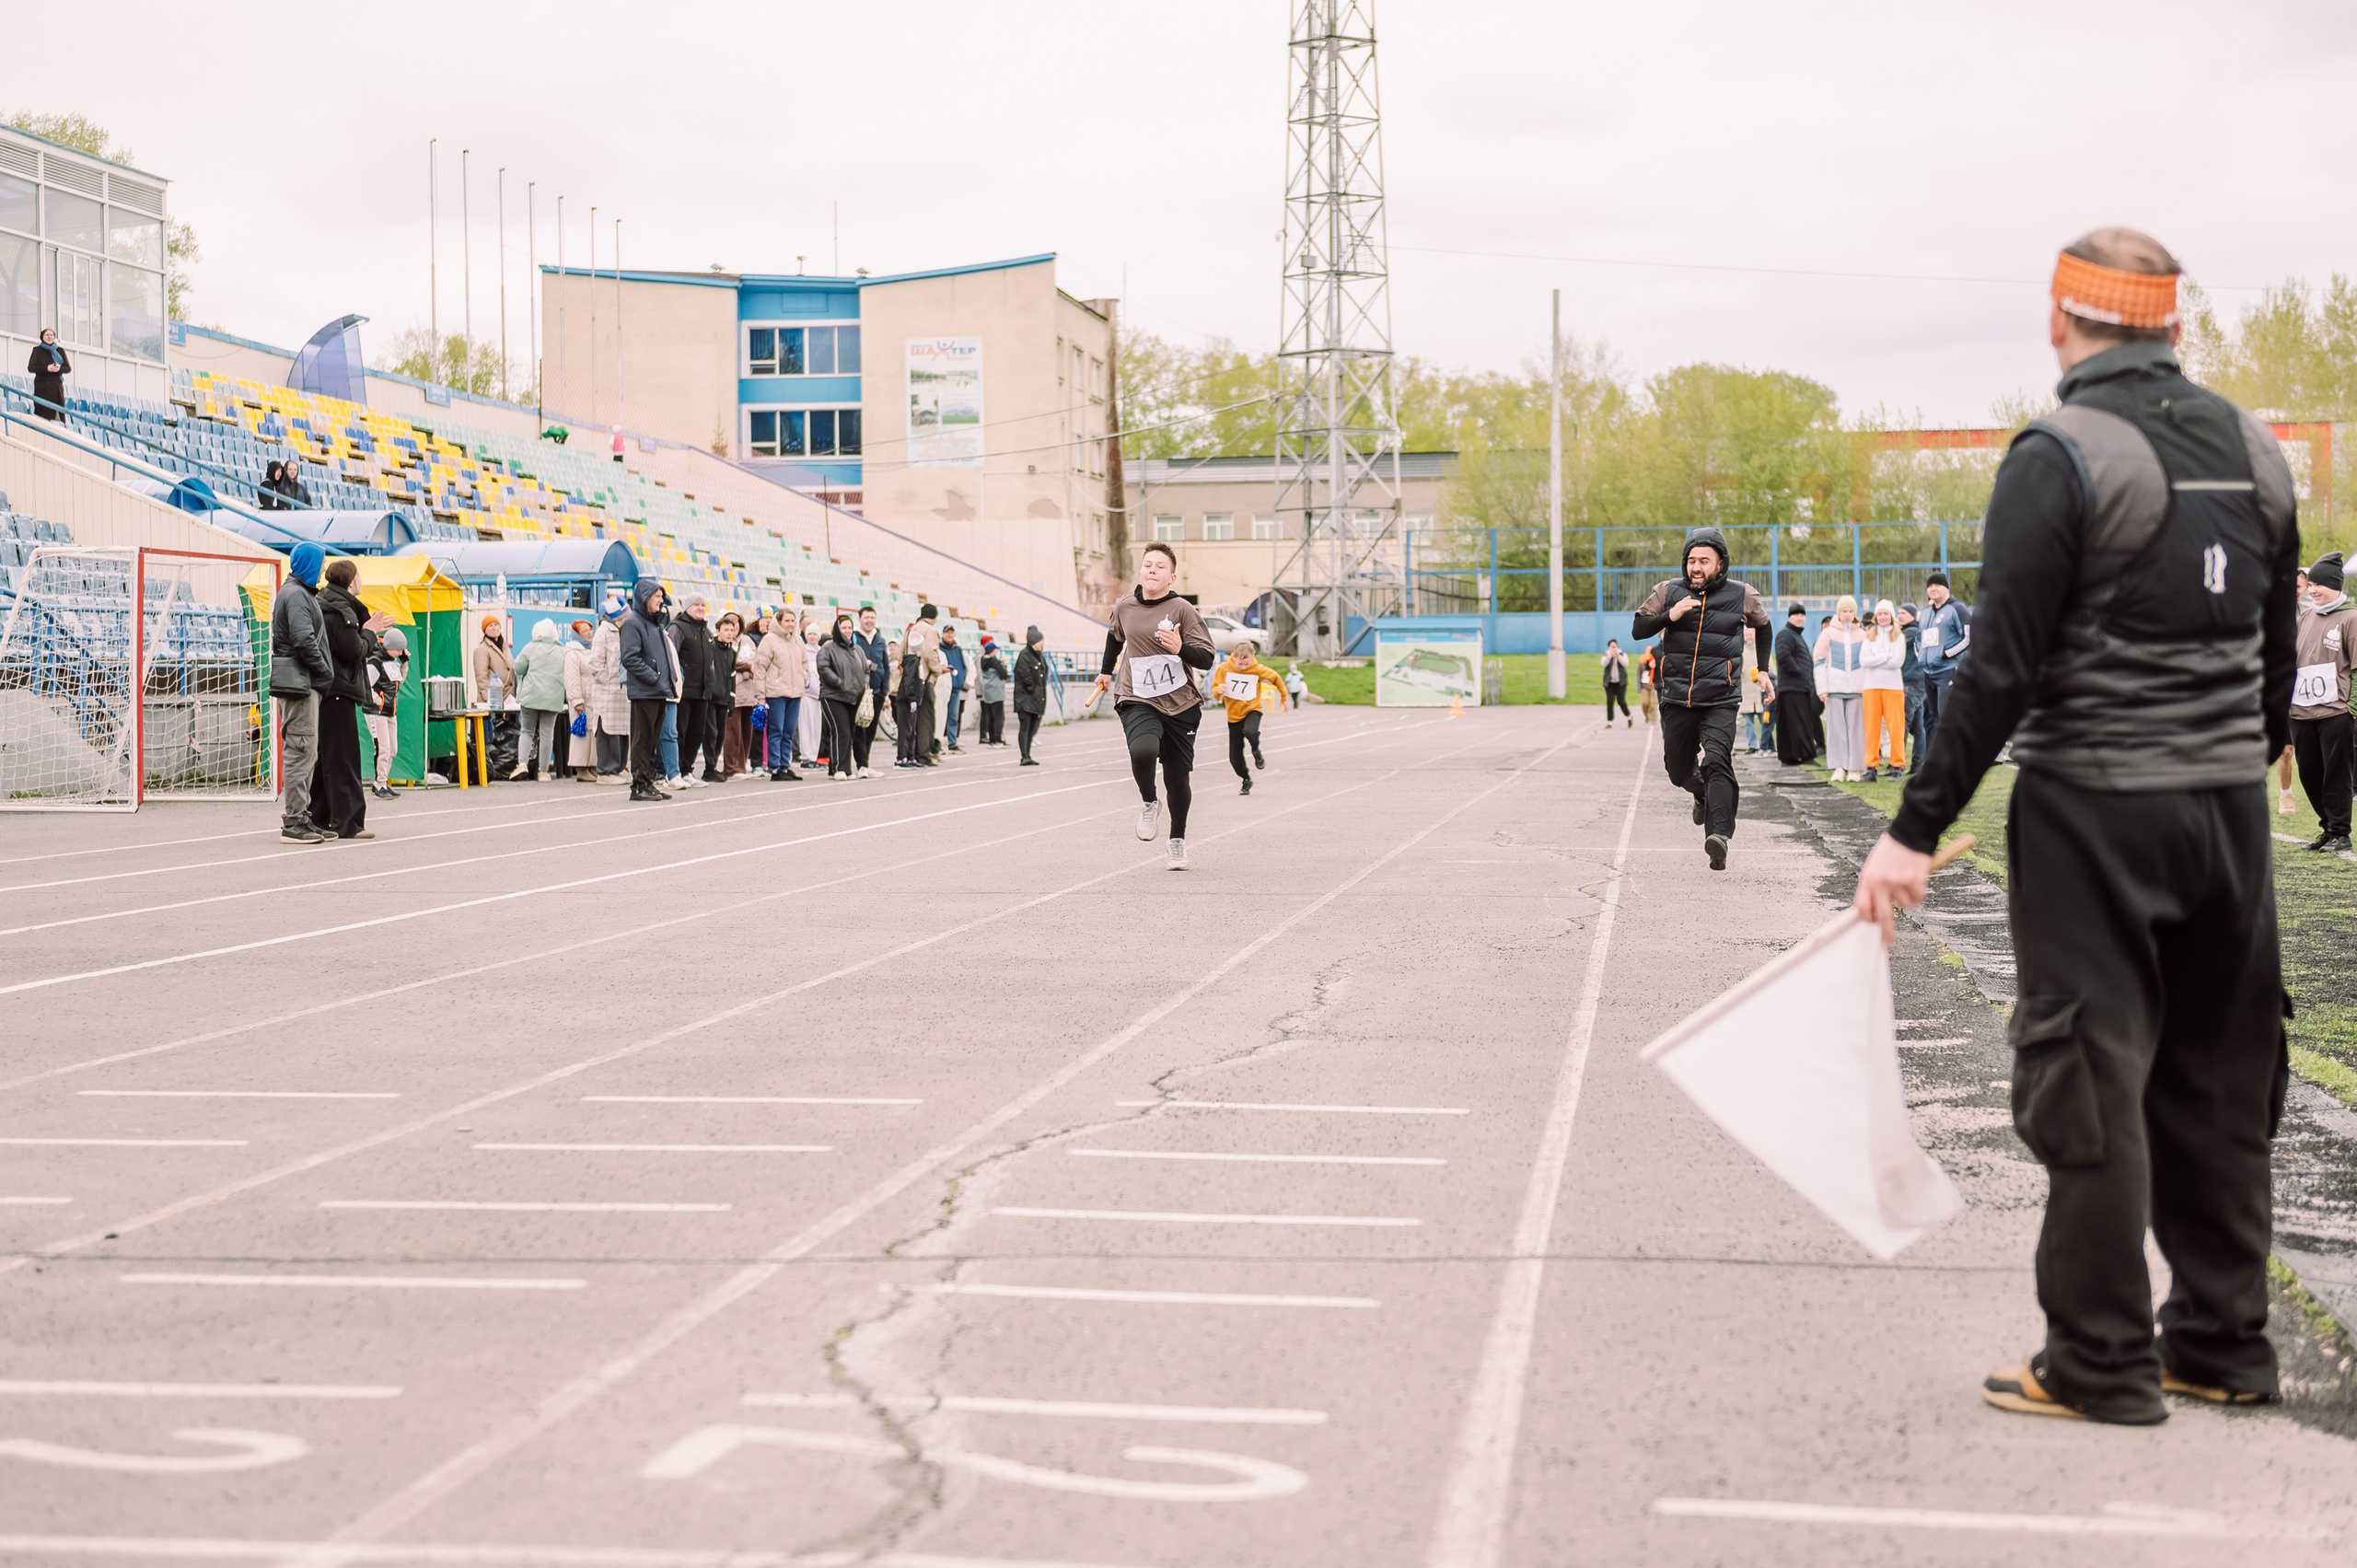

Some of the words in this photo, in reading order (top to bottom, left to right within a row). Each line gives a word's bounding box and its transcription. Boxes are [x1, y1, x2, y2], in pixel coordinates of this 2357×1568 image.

[1144, 663, 1175, 691] 44
[1231, 679, 1249, 693] 77
[2298, 676, 2326, 700] 40
